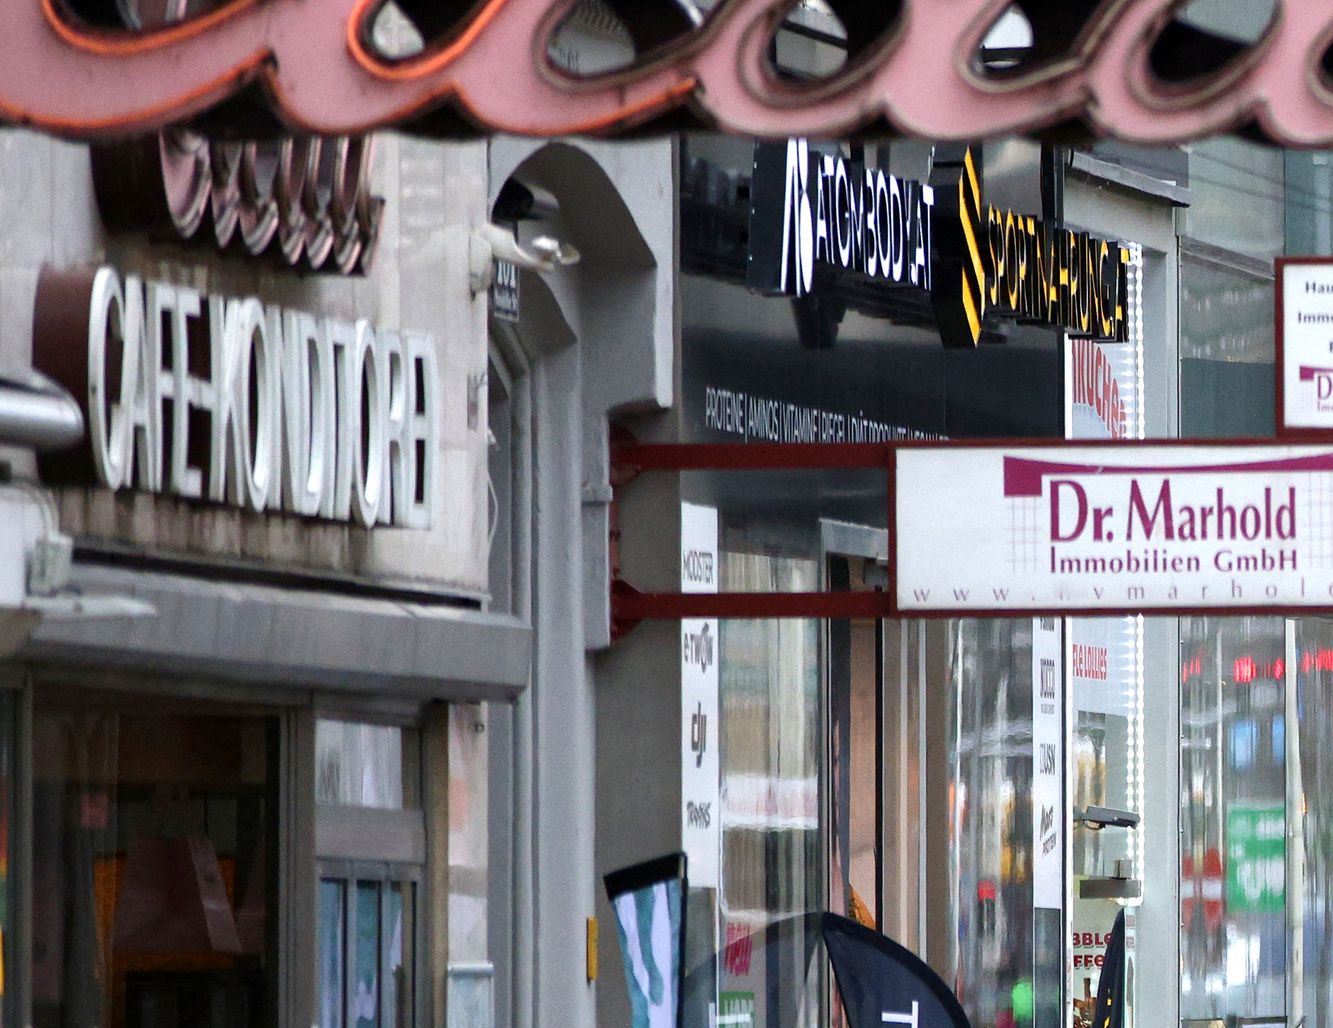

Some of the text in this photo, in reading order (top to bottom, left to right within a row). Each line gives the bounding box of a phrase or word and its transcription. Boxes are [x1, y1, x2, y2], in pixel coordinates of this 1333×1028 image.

[705, 387, 744, 435] PROTEINE
[749, 397, 779, 443] AMINOS
[1050, 479, 1297, 542] Dr. Marhold
[1050, 547, 1298, 573] Immobilien GmbH
